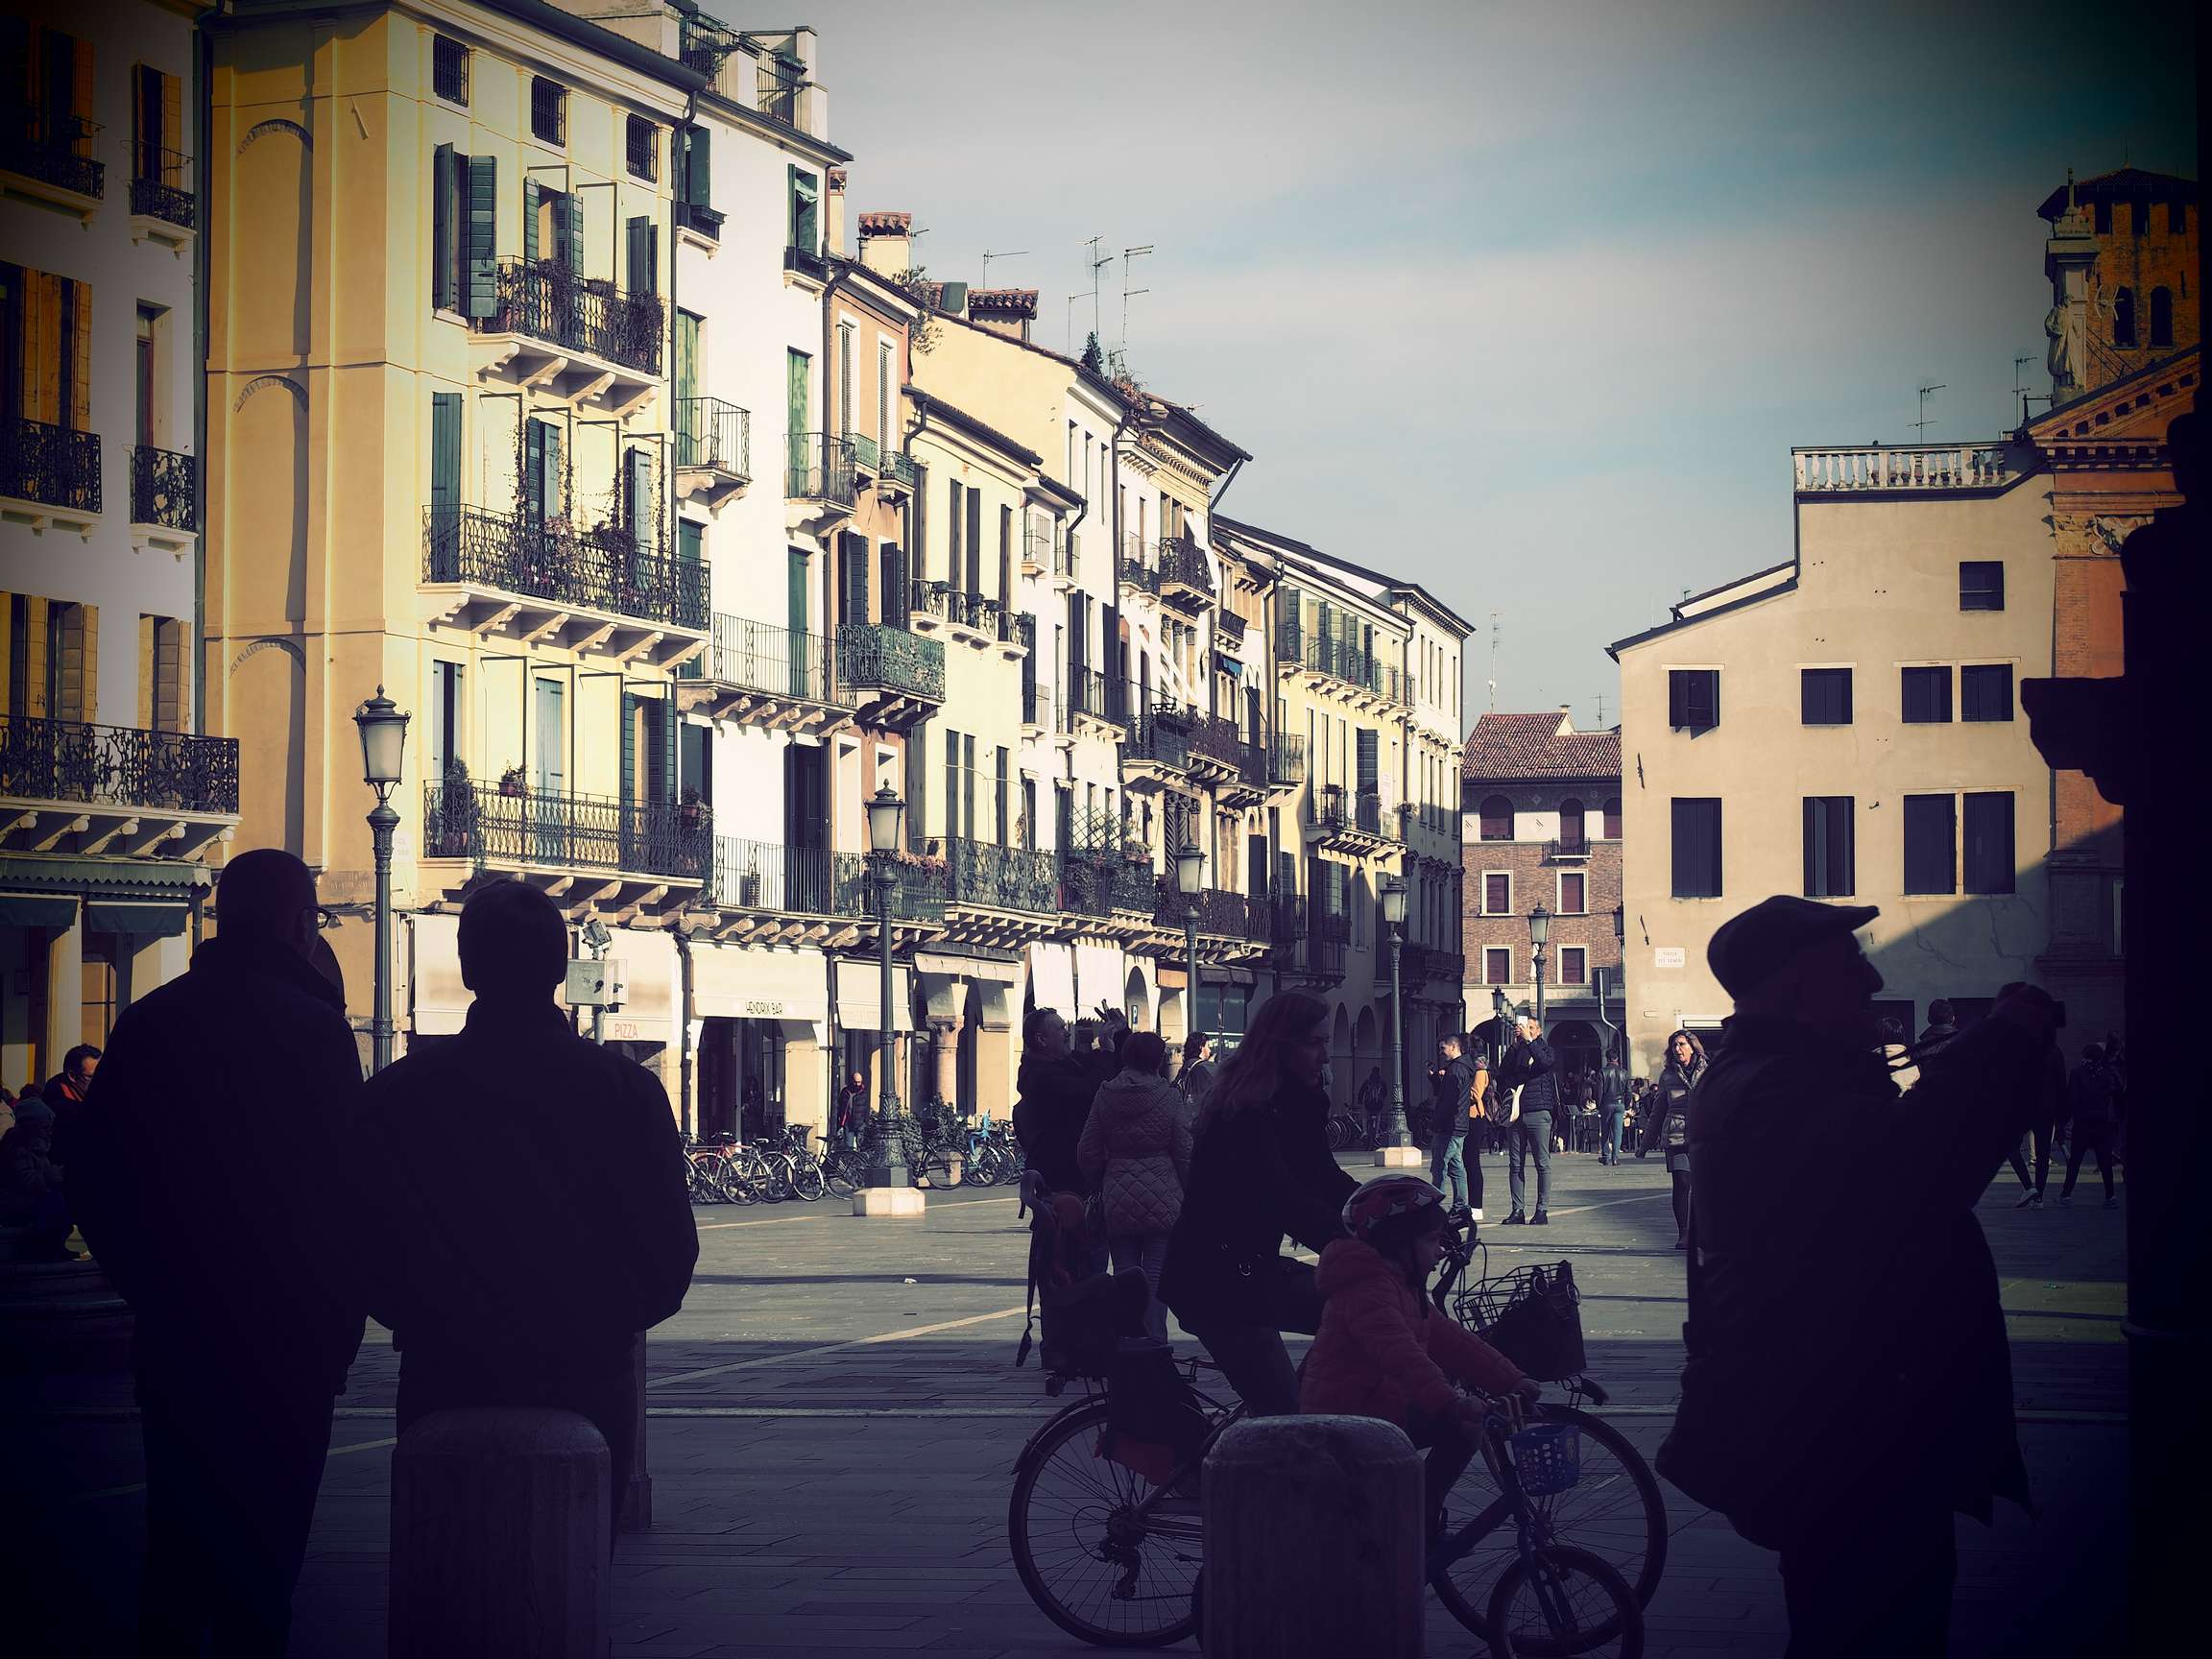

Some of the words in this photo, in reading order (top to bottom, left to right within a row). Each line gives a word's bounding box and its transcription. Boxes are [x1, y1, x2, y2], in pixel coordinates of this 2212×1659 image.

[745, 1001, 770, 1015] HENDRIX
[771, 1002, 783, 1016] BAR
[614, 1022, 637, 1038] PIZZA
